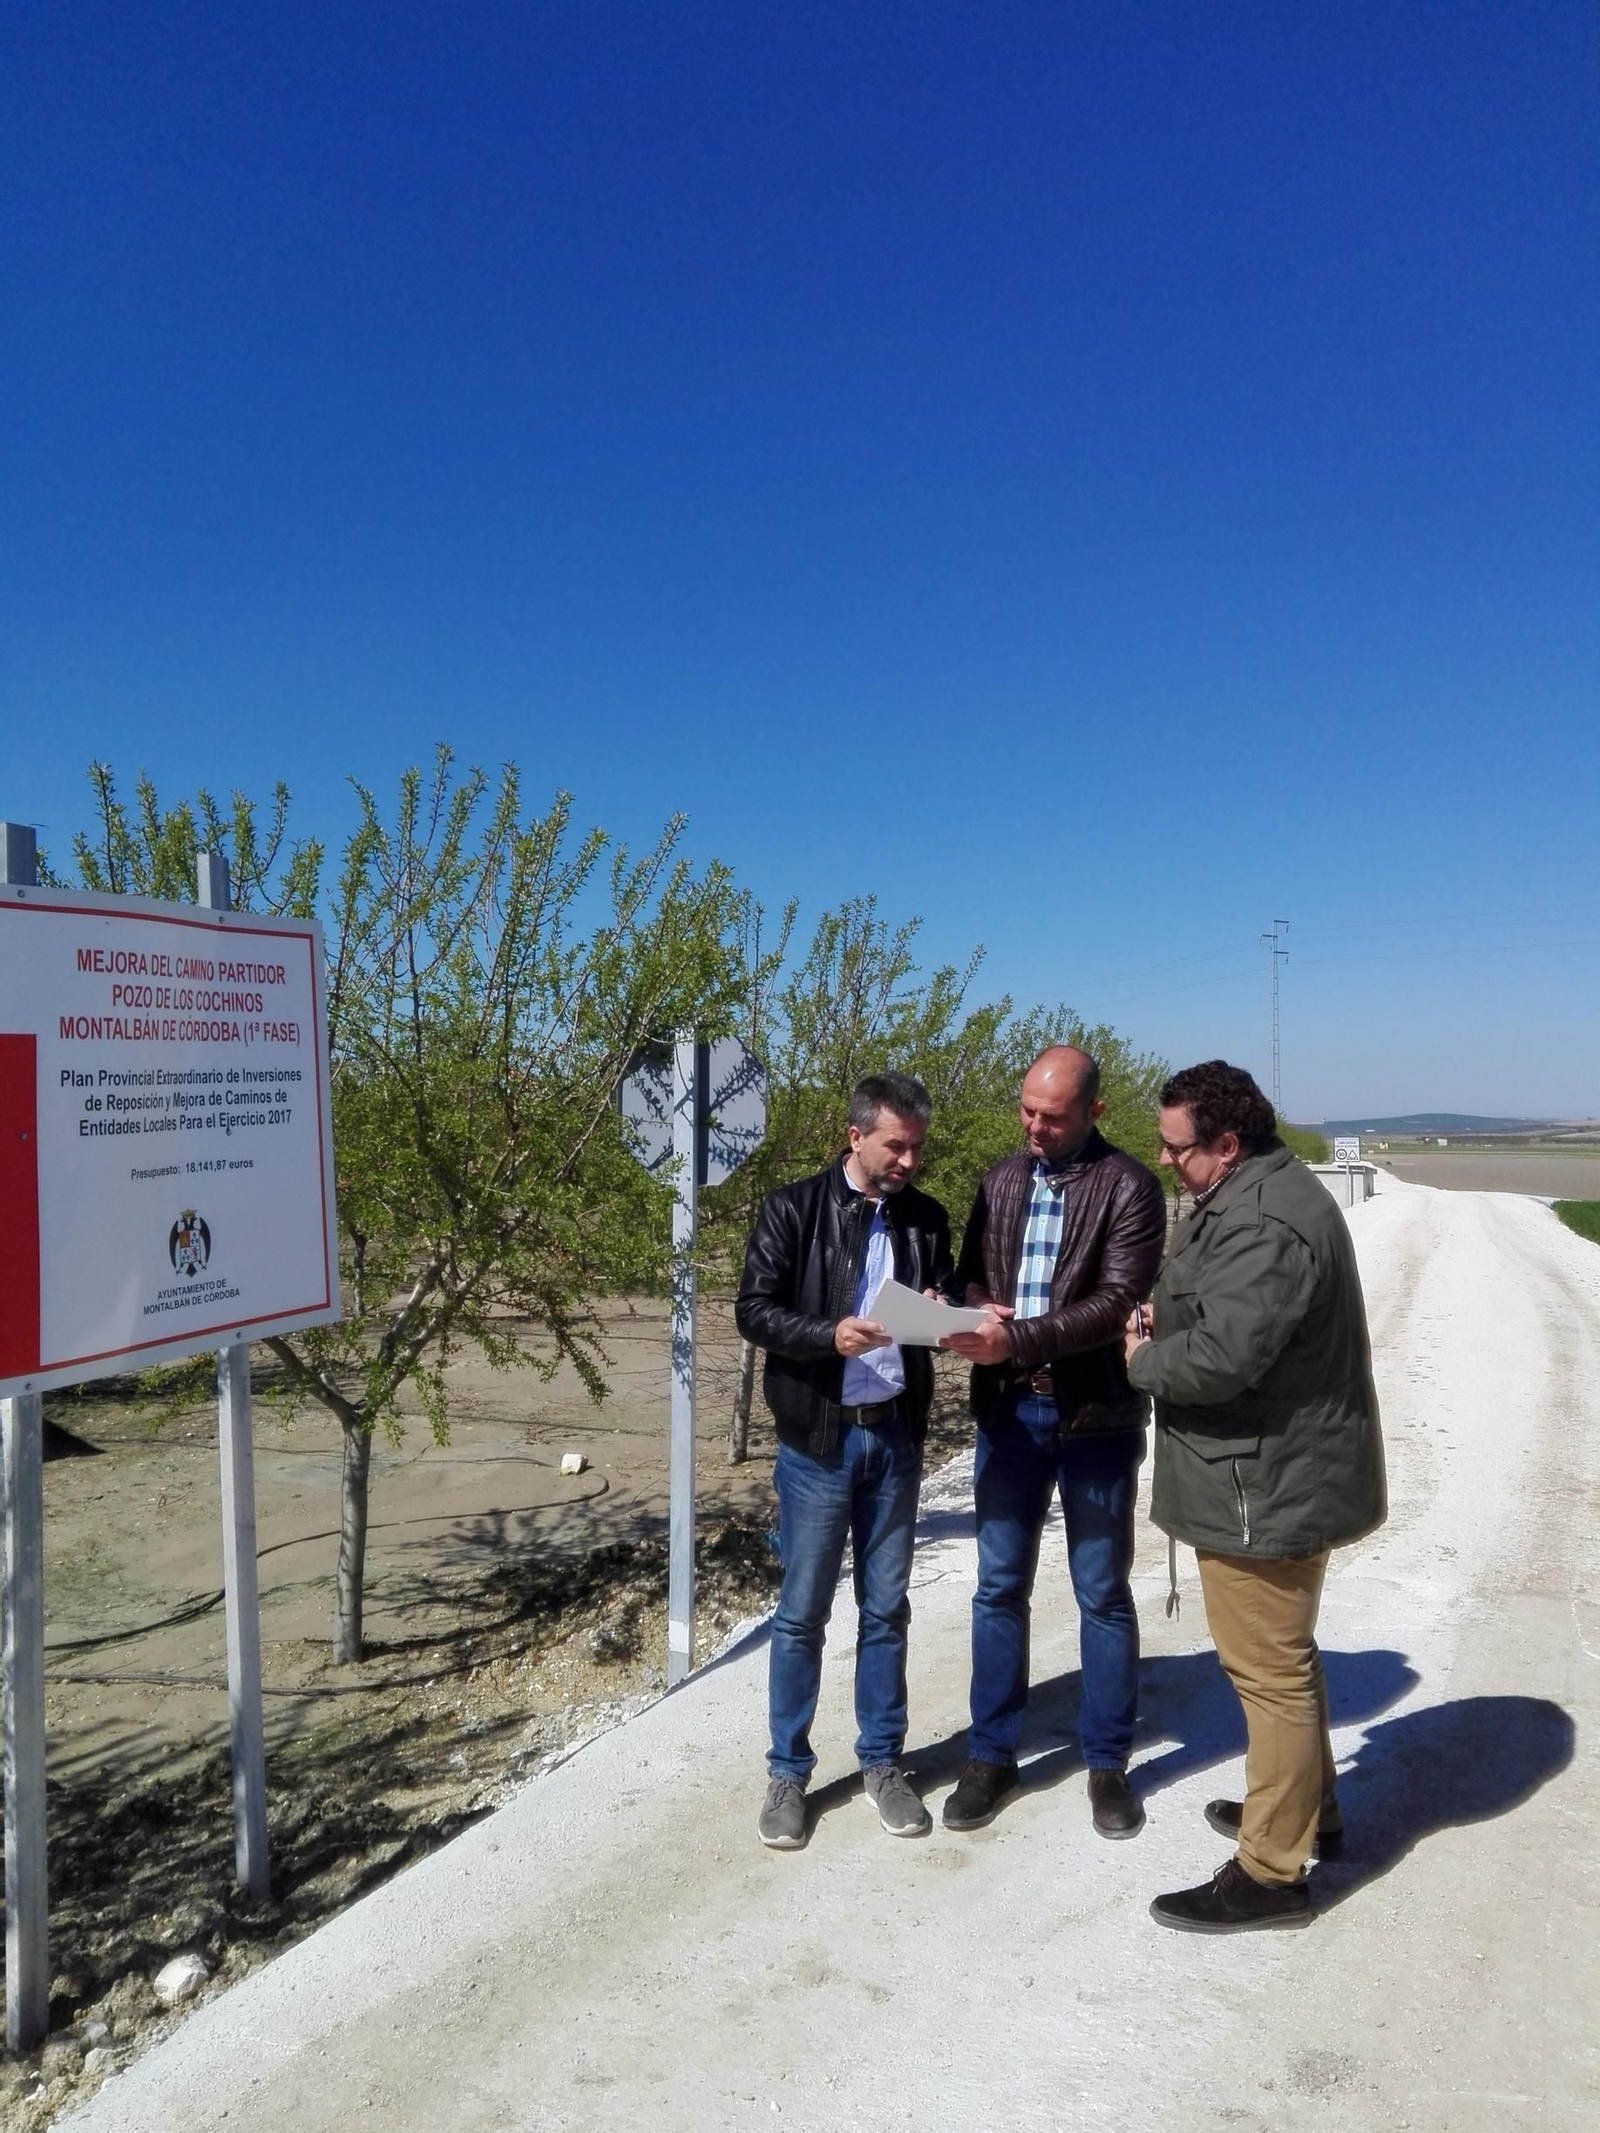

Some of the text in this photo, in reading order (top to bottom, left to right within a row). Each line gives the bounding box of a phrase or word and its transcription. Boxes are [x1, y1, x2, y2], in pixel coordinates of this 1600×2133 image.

[77, 949, 286, 985] MEJORA DEL CAMINO PARTIDOR
[112, 984, 263, 1013] POZO DE LOS COCHINOS
[60, 1012, 160, 1040] MONTALBÁN
[162, 1019, 176, 1041] DE
[178, 1015, 240, 1042] CÓRDOBA
[263, 1022, 300, 1047] FASE)
[60, 1067, 302, 1087] Plan Provincial Extraordinario de Inversiones
[84, 1088, 288, 1114] de Reposición y Mejora de Caminos de
[79, 1109, 292, 1137] Entidades Locales Para el Ejercicio 2017
[131, 1159, 254, 1180] Presupuesto: 18.141,87 euros
[157, 1279, 226, 1300] AYUNTAMIENTO DE
[143, 1297, 190, 1315] MONTALBÁN
[192, 1295, 202, 1305] DE
